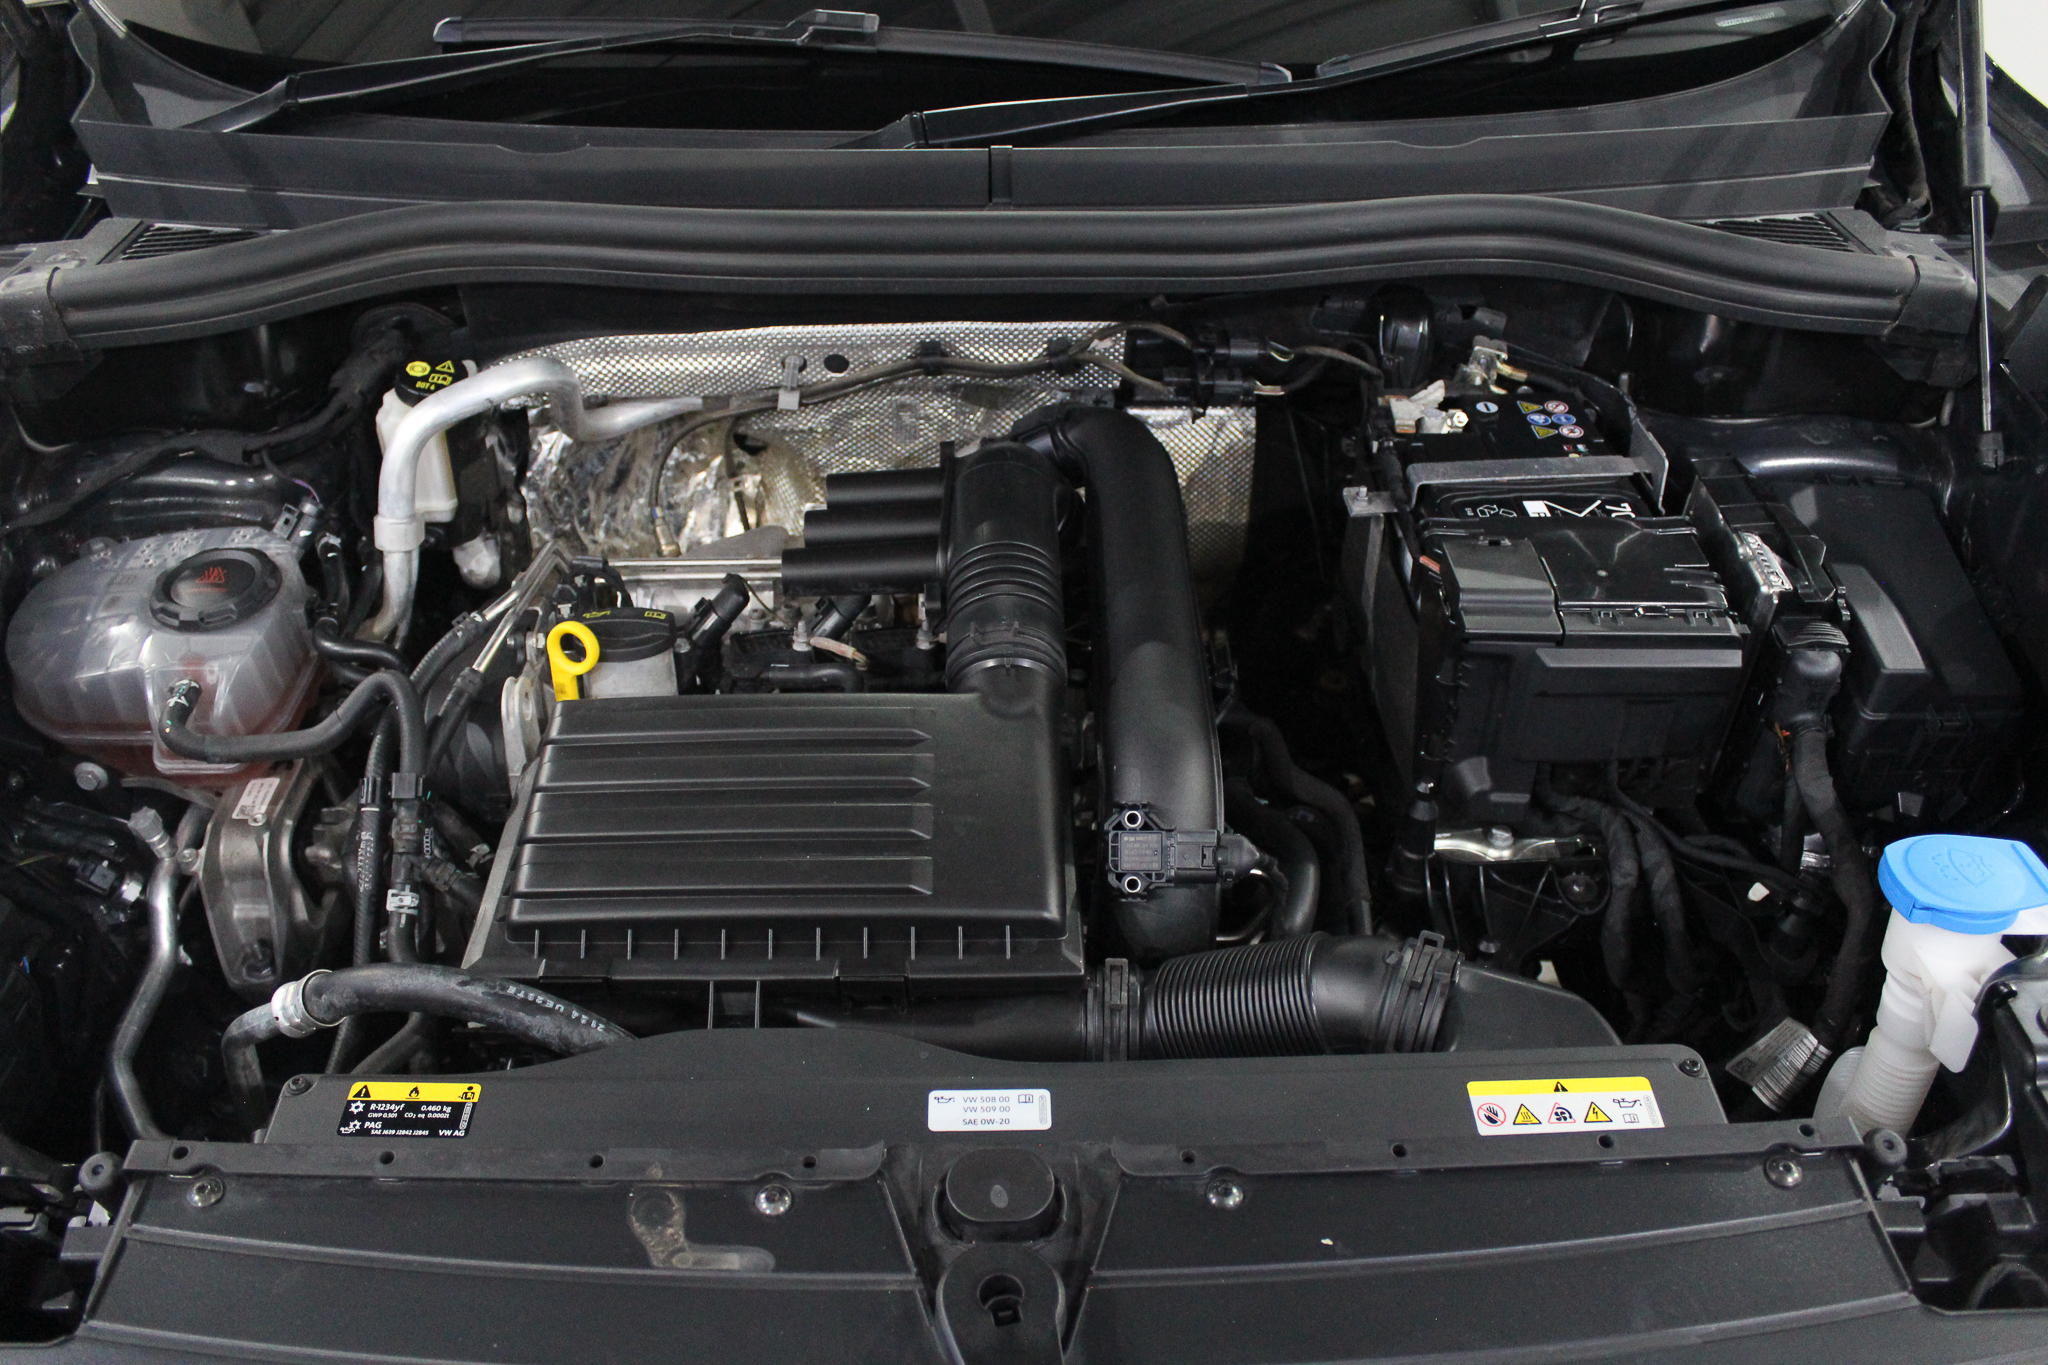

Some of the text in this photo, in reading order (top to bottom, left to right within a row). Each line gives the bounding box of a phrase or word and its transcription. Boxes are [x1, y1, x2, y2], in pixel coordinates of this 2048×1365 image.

[415, 381, 430, 389] DOT
[370, 1103, 405, 1112] R-1234yf
[443, 1105, 451, 1113] kg
[364, 1121, 382, 1129] PAG
[453, 1129, 465, 1137] AG
